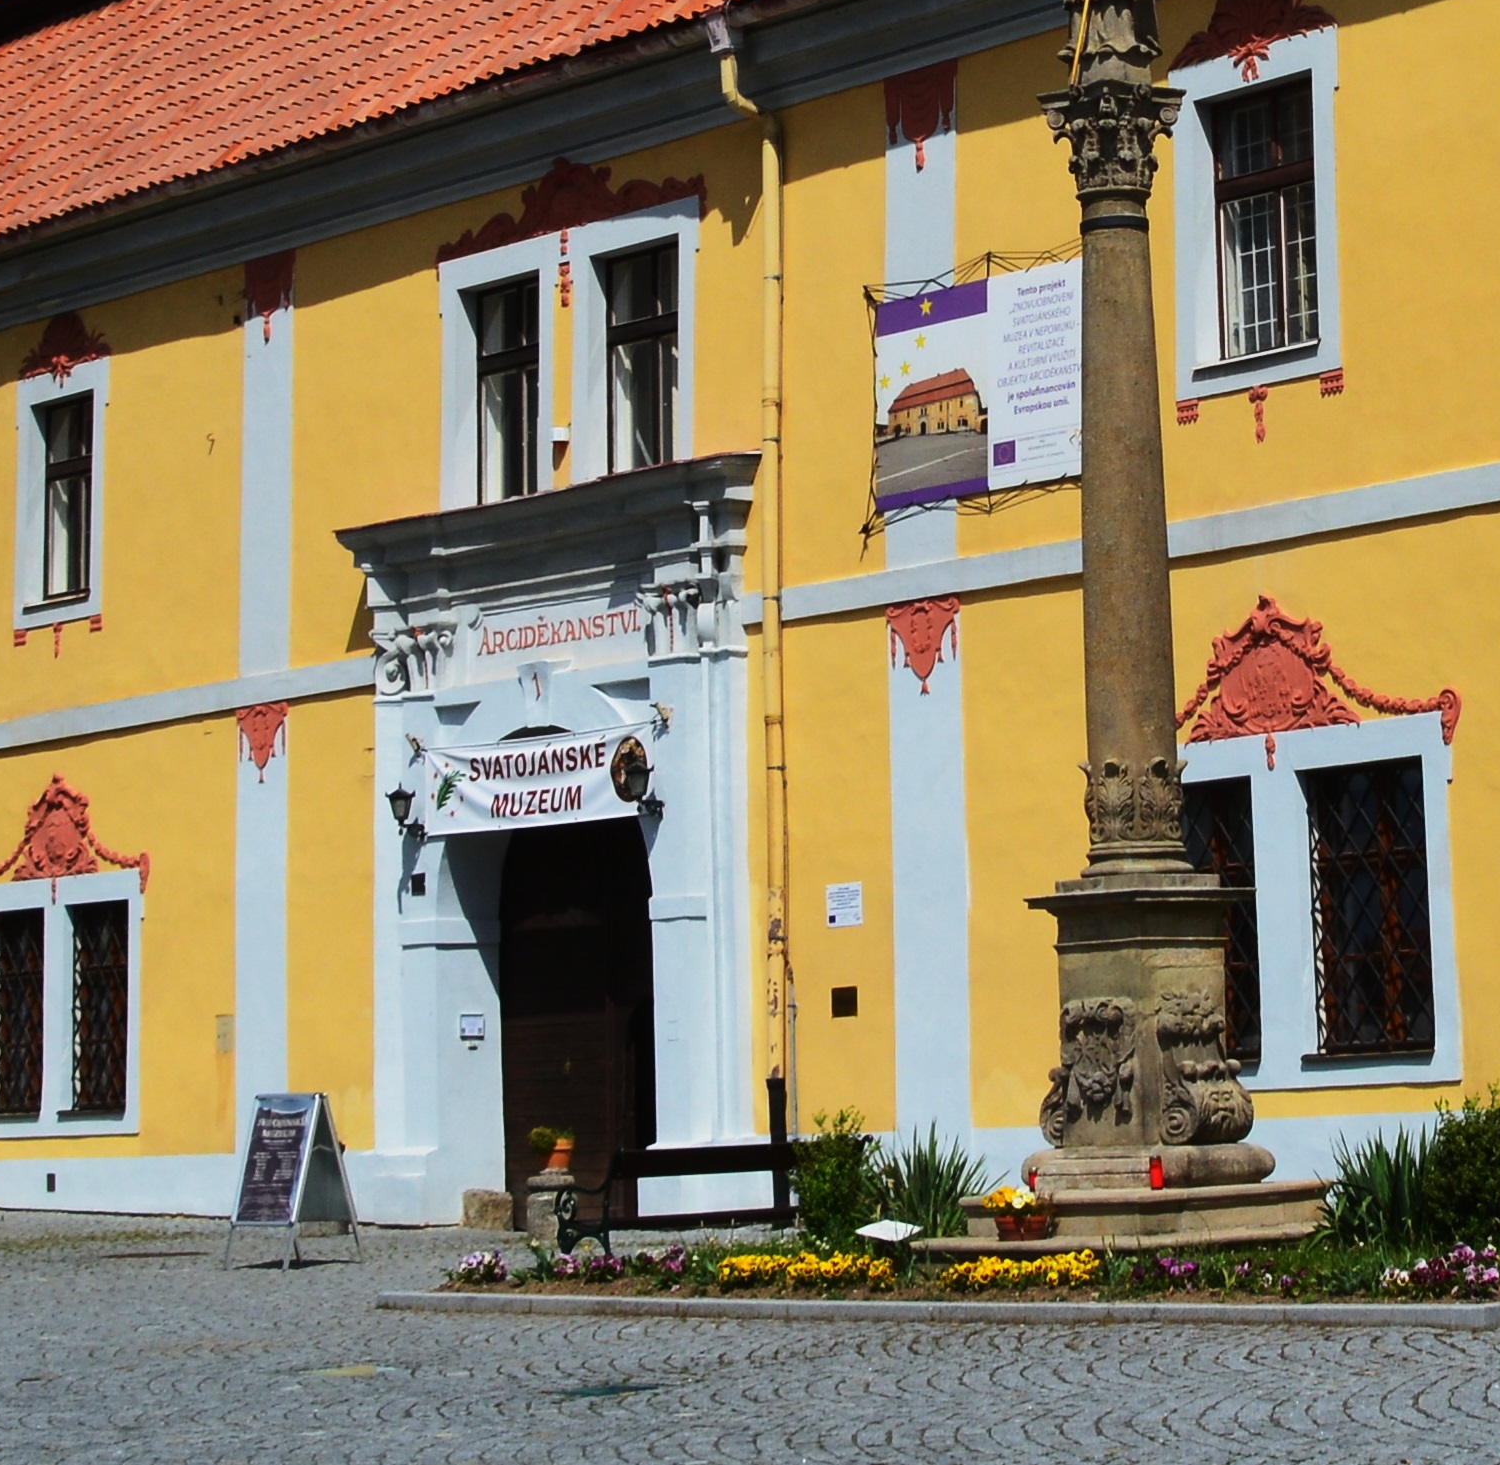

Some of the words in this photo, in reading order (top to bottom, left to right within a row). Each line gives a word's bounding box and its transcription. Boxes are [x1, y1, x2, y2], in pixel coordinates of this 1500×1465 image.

[1017, 286, 1038, 296] Tento
[1039, 279, 1066, 294] projekt
[1003, 329, 1027, 343] MUZEA
[1035, 320, 1076, 336] NEPOMUKU
[1017, 336, 1065, 354] REVITALIZACE
[997, 374, 1028, 388] OBJEKTU
[1007, 392, 1014, 403] je
[1016, 380, 1076, 401] spolufinancován
[1014, 400, 1052, 415] Evropskou
[531, 672, 541, 701] 1
[468, 735, 607, 782] SVATOJÁNSKÉ
[491, 785, 582, 818] MUZEUM
